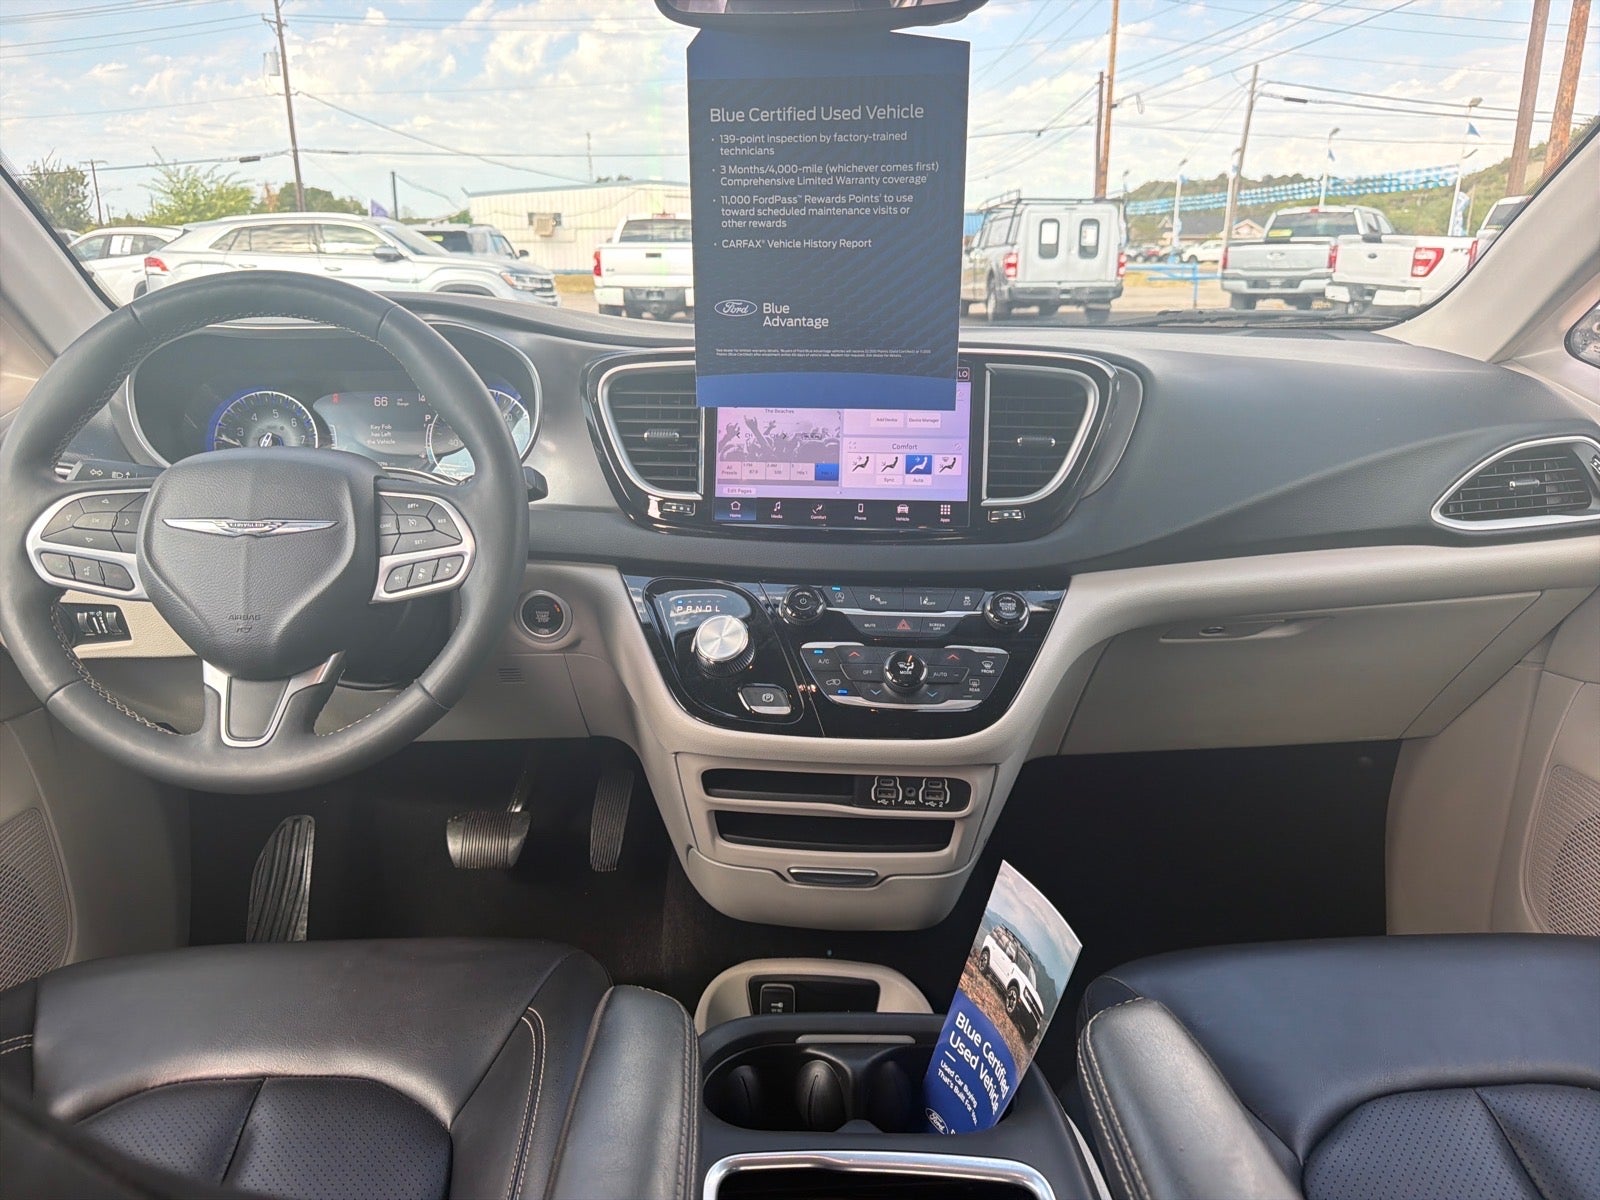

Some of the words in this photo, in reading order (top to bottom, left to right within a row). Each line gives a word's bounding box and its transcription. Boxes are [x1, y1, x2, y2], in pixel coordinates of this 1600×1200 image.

[710, 107, 745, 122] Blue
[748, 106, 816, 122] Certified
[820, 105, 862, 121] Used
[865, 104, 924, 120] Vehicle
[720, 134, 765, 145] 139-point
[766, 134, 818, 145] inspection
[819, 133, 832, 144] by
[833, 131, 908, 143] factory-trained
[720, 146, 775, 156] technicians
[720, 166, 727, 175] 3
[728, 164, 823, 176] Months/4,000-mile
[825, 162, 878, 174] (whichever
[880, 164, 914, 173] comes
[915, 162, 940, 172] first)
[720, 176, 796, 188] Comprehensive
[797, 176, 834, 186] Limited
[836, 175, 880, 186] Warranty
[720, 195, 750, 206] 11,000
[804, 194, 847, 204] Rewards
[883, 194, 894, 203] to
[895, 194, 914, 202] use
[720, 207, 755, 216] toward
[756, 206, 806, 216] scheduled
[808, 206, 871, 216] maintenance
[872, 205, 898, 215] visits
[900, 206, 910, 215] or
[721, 218, 747, 228] other
[748, 218, 788, 228] rewards
[766, 238, 802, 248] Vehicle
[803, 238, 838, 250] History
[838, 238, 872, 250] Report
[720, 300, 752, 315] Ford
[762, 302, 790, 314] Blue
[762, 316, 830, 330] Advantage
[374, 396, 388, 407] 66
[251, 412, 258, 422] 4
[272, 409, 280, 419] 5
[290, 418, 298, 428] 6
[236, 427, 244, 436] 3
[300, 435, 306, 444] 7
[955, 1011, 982, 1048] Blue
[982, 1041, 1010, 1100] Certified
[949, 1030, 980, 1070] Used
[980, 1062, 1000, 1116] Vehicle
[938, 1068, 954, 1090] That's
[953, 1086, 966, 1104] Built
[964, 1099, 972, 1112] For
[940, 1059, 955, 1078] Used
[954, 1074, 964, 1087] Car
[963, 1084, 978, 1109] Buying
[928, 1111, 946, 1132] Ford
